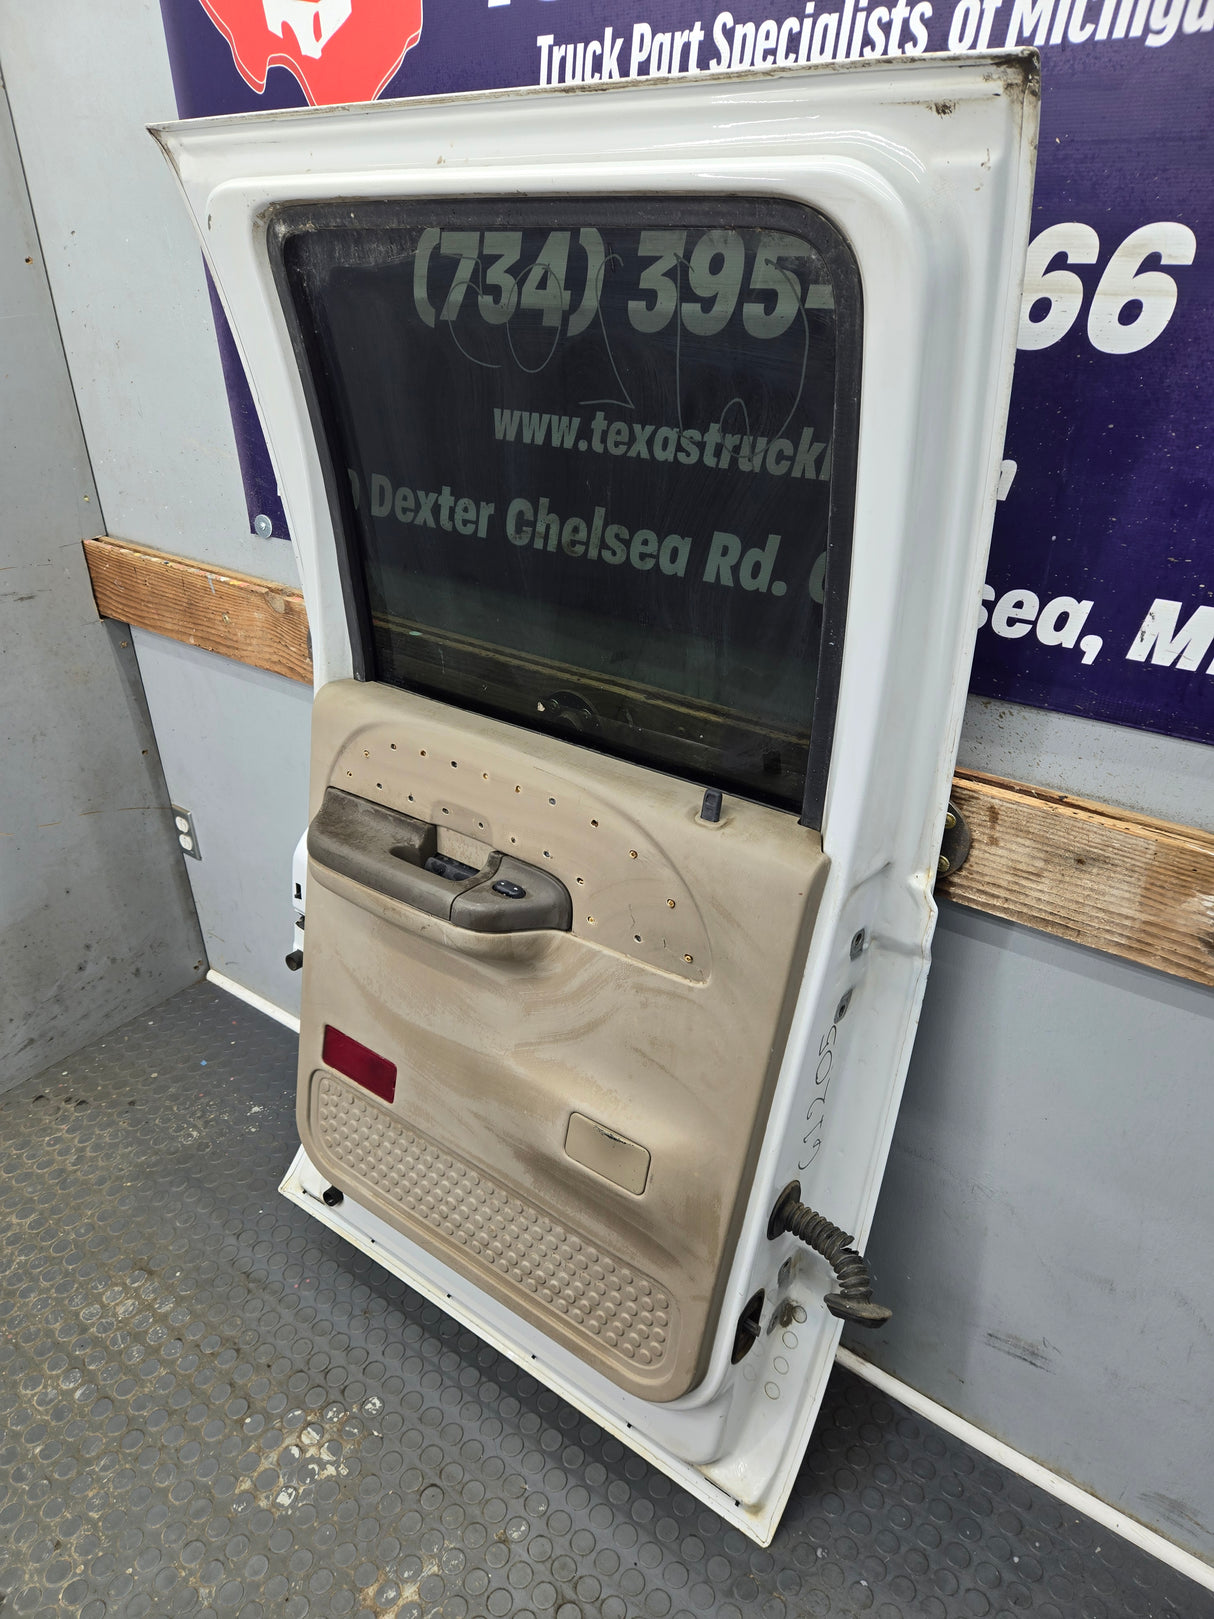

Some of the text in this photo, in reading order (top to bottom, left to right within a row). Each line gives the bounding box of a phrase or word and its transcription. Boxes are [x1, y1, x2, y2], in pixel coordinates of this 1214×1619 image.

[537, 34, 624, 86] Truck
[630, 22, 705, 77] Part
[709, 0, 933, 71] Specialists
[948, 0, 1002, 52] of
[413, 227, 605, 337] (734)
[371, 473, 494, 538] Dexter
[506, 497, 693, 578] Chelsea
[703, 531, 788, 597] Rd.
[1125, 598, 1214, 676] M
